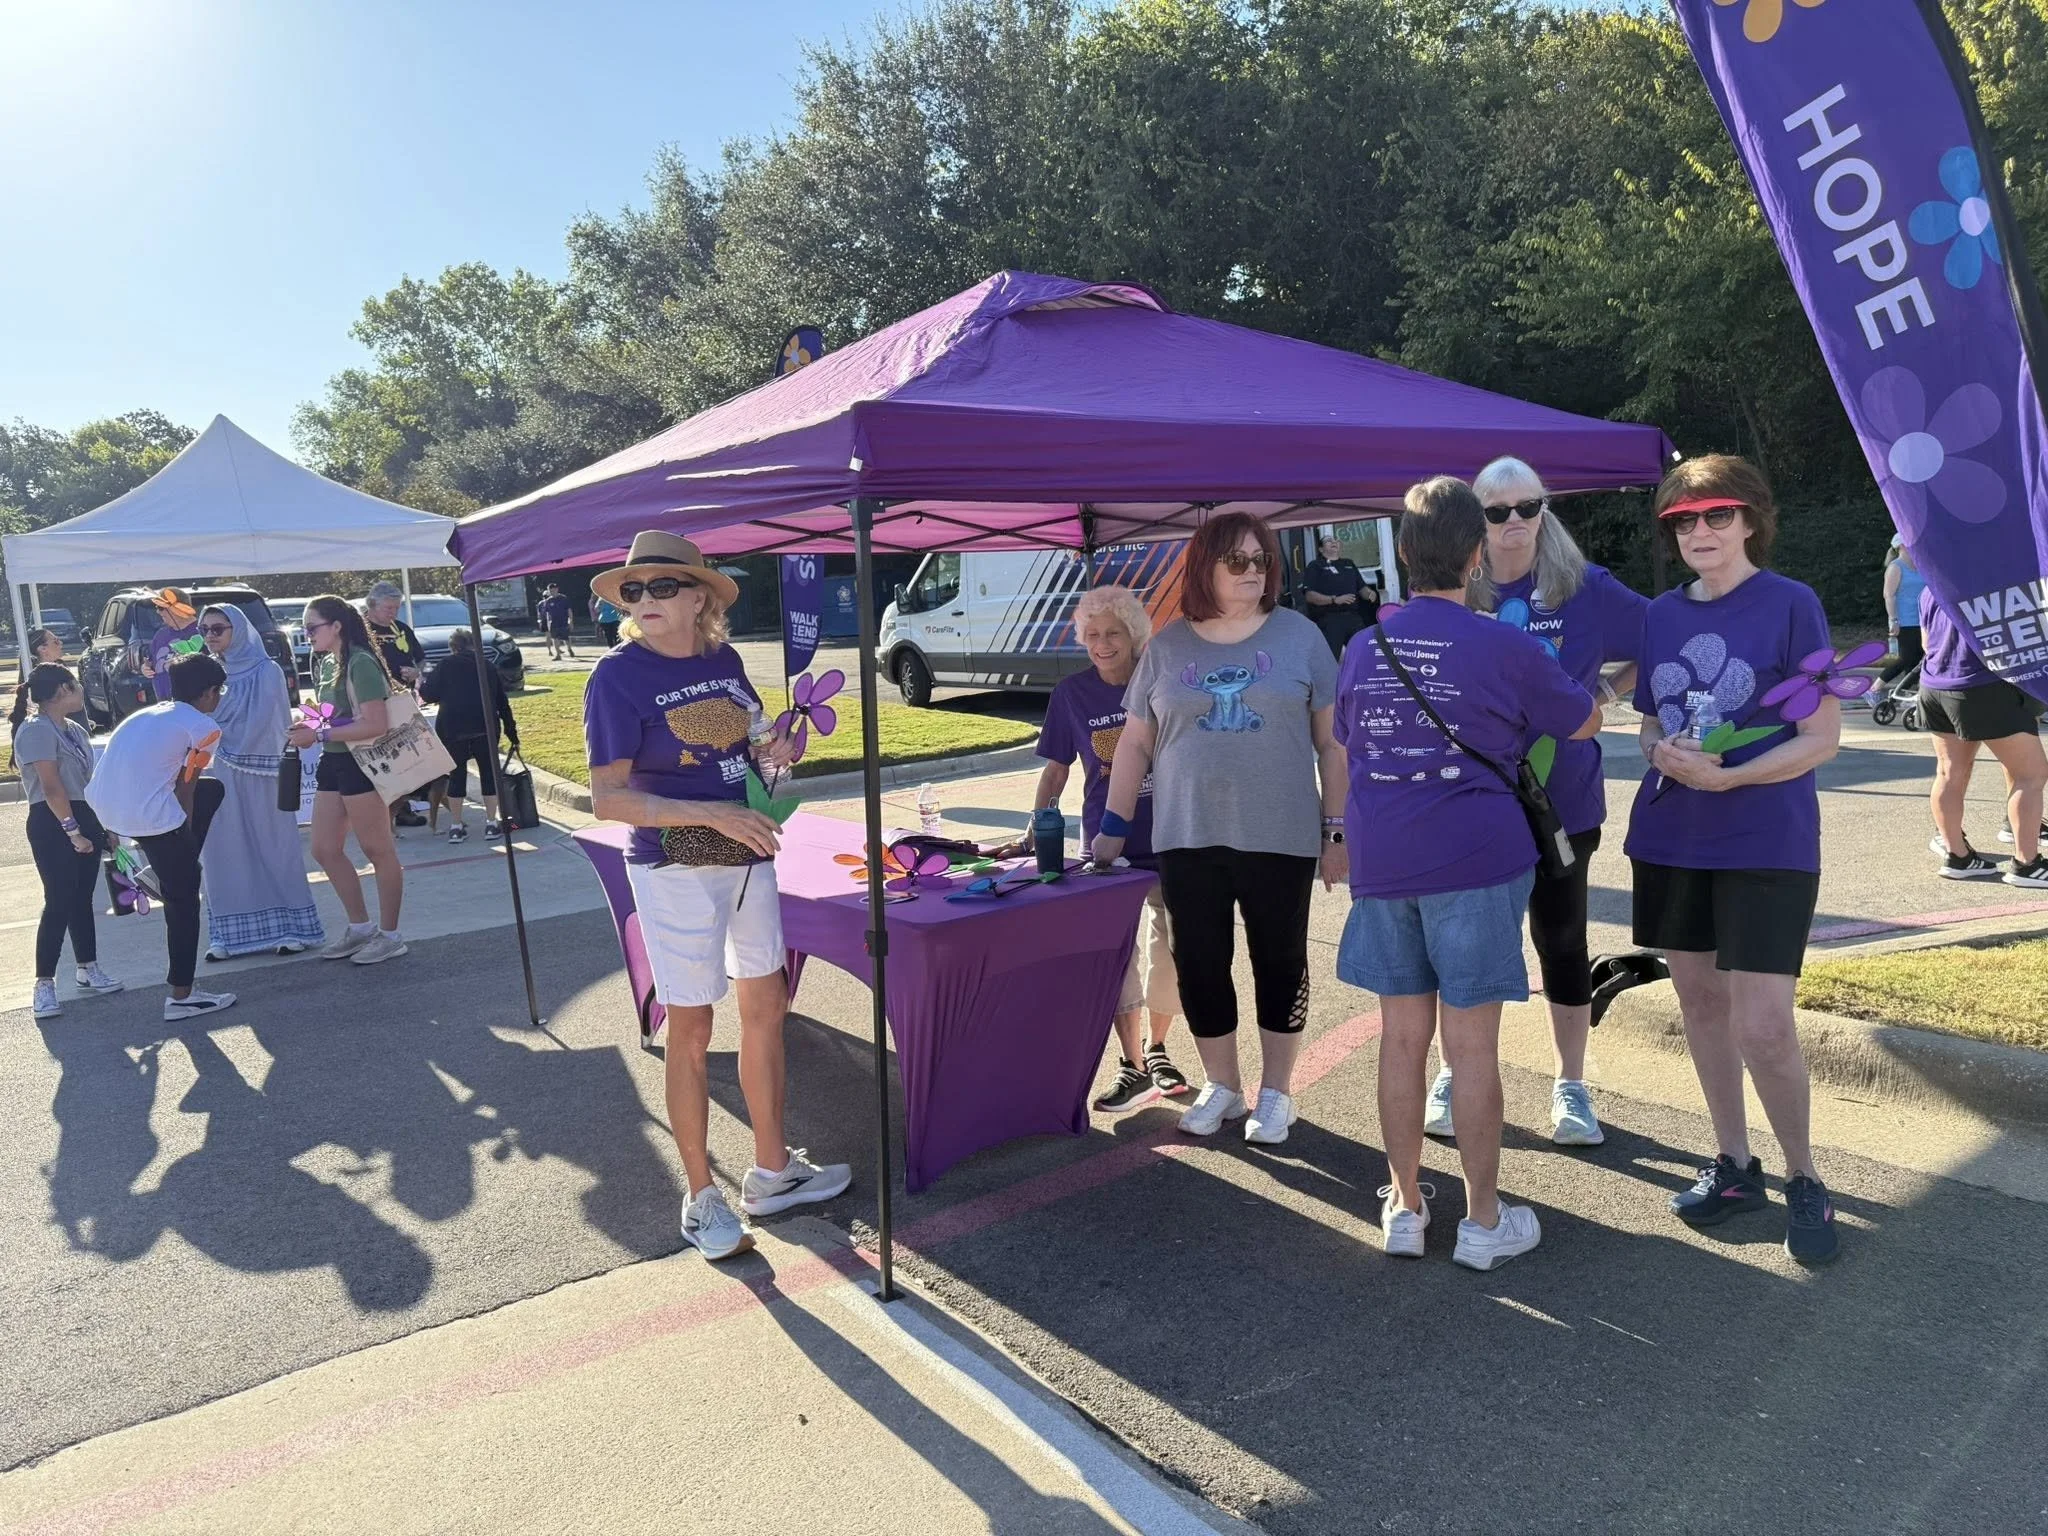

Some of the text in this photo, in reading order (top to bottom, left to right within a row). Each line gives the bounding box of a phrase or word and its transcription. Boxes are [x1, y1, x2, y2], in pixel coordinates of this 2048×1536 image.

[1782, 83, 1936, 351] HOPE
[789, 610, 819, 627] WALK
[1529, 619, 1563, 632] NOW
[797, 624, 818, 639] END
[1980, 634, 2003, 648] TO
[1393, 647, 1417, 658] Edward
[1416, 649, 1440, 660] Jones
[1986, 645, 2048, 672] ALZHE
[655, 677, 740, 706] OUR TIME IS NOW
[1088, 711, 1128, 727] OUR TIM
